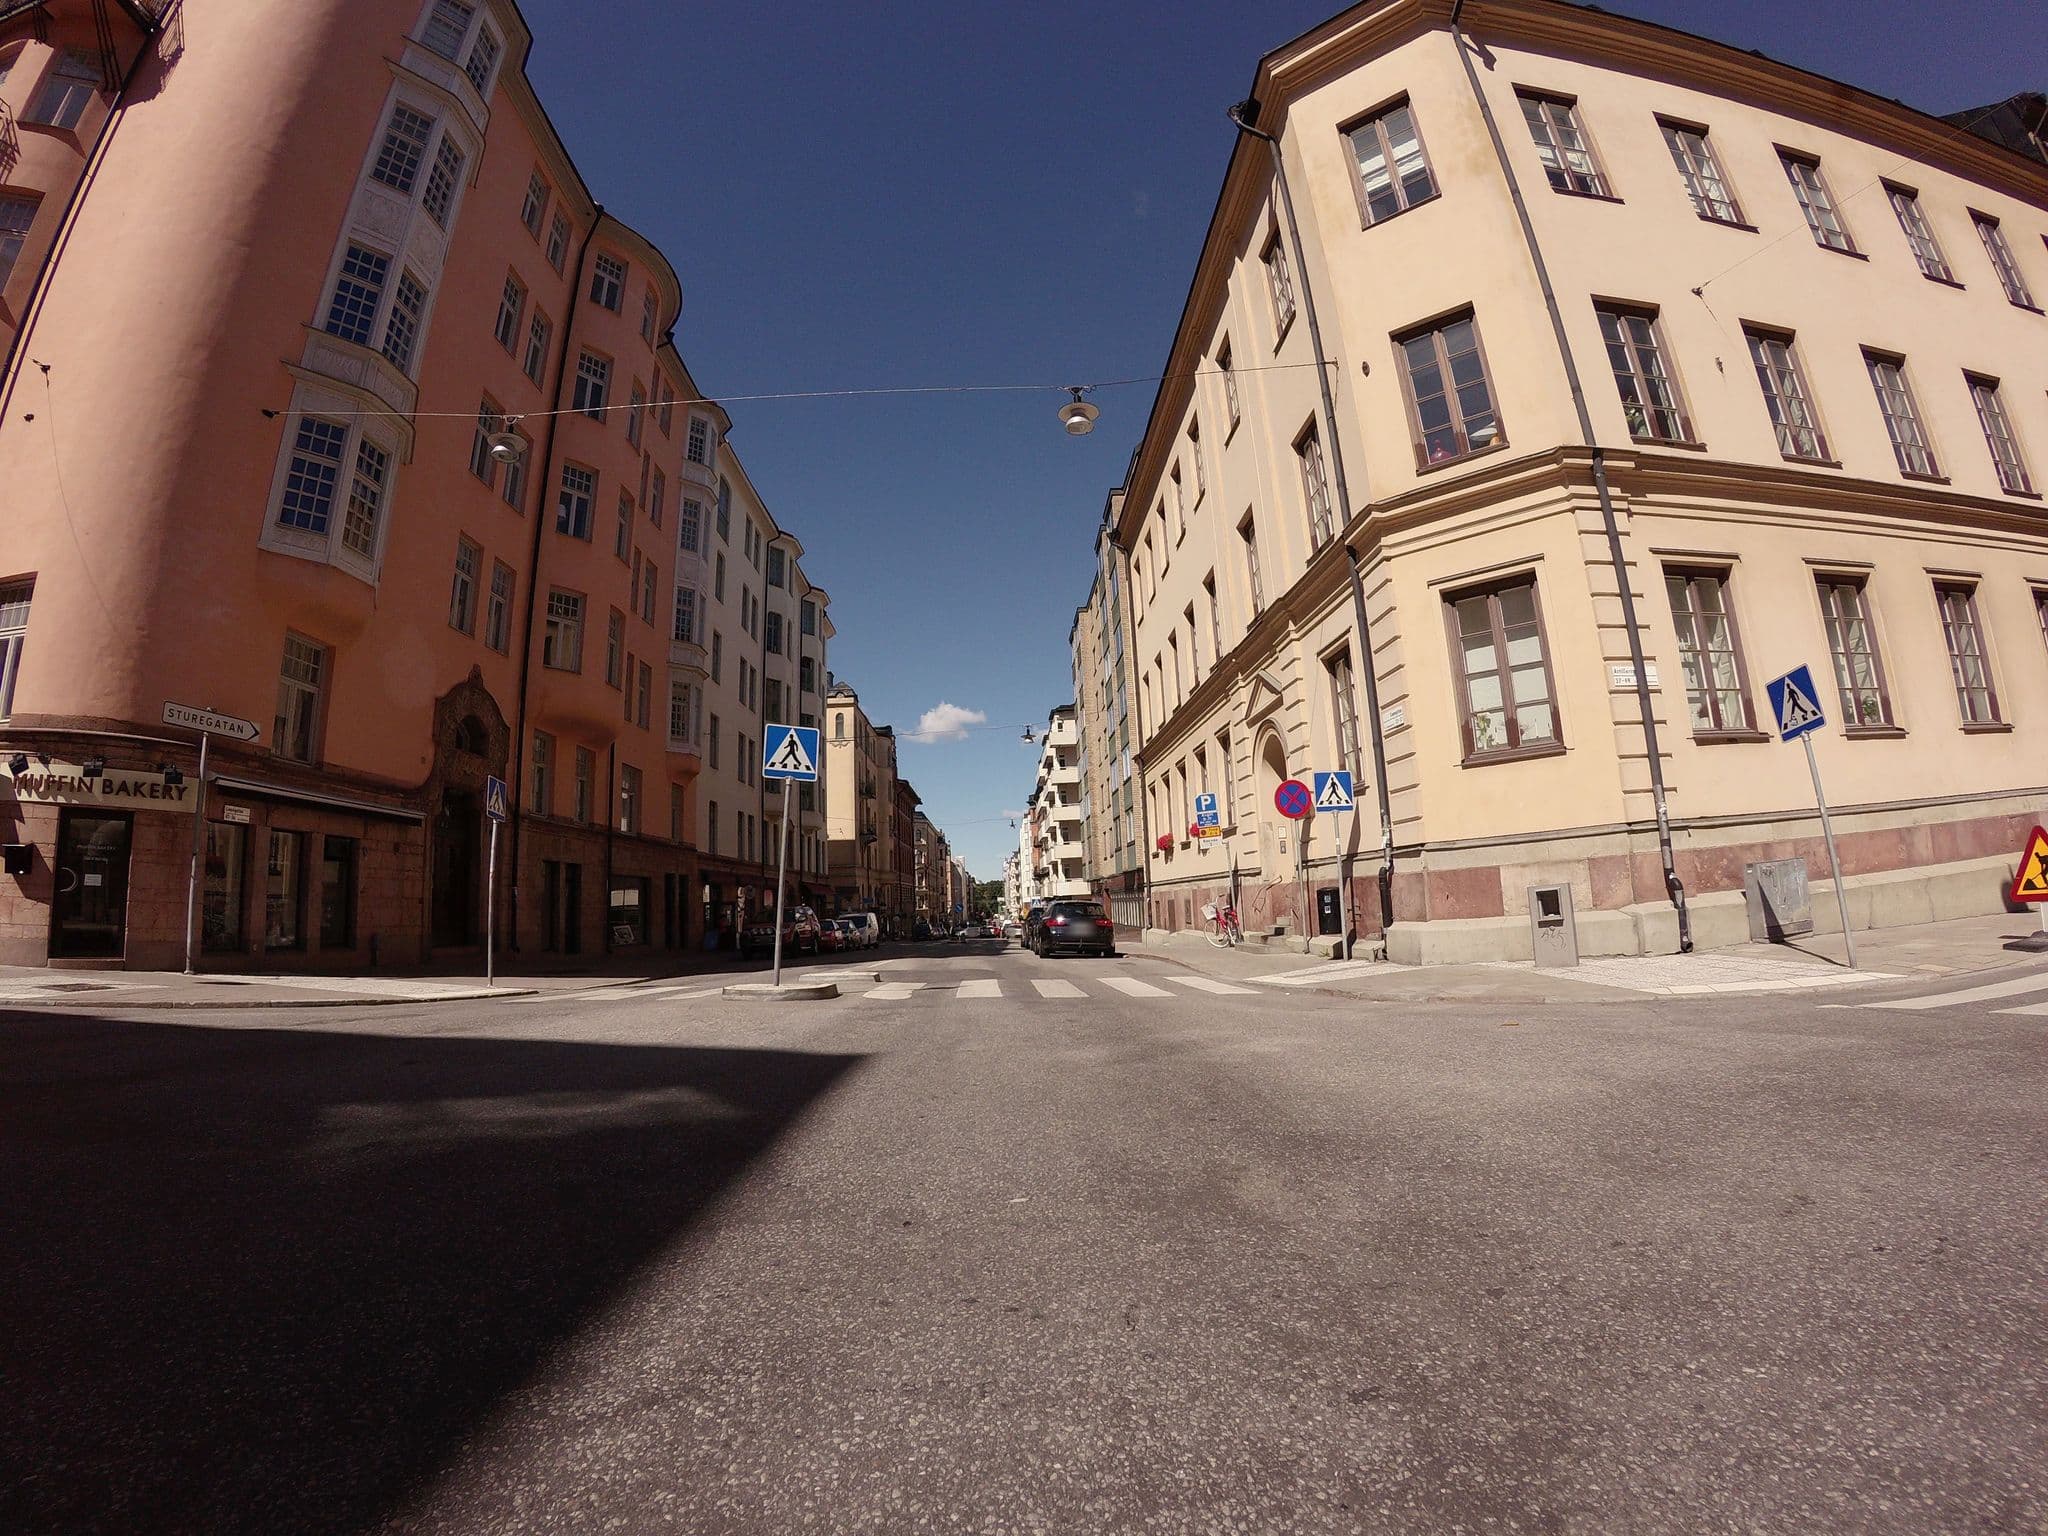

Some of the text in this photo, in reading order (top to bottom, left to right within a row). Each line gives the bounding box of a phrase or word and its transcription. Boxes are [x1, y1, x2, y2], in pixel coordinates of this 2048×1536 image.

[167, 708, 244, 734] STUREGATAN
[14, 773, 188, 801] MUFFIN BAKERY
[1200, 795, 1212, 811] P
